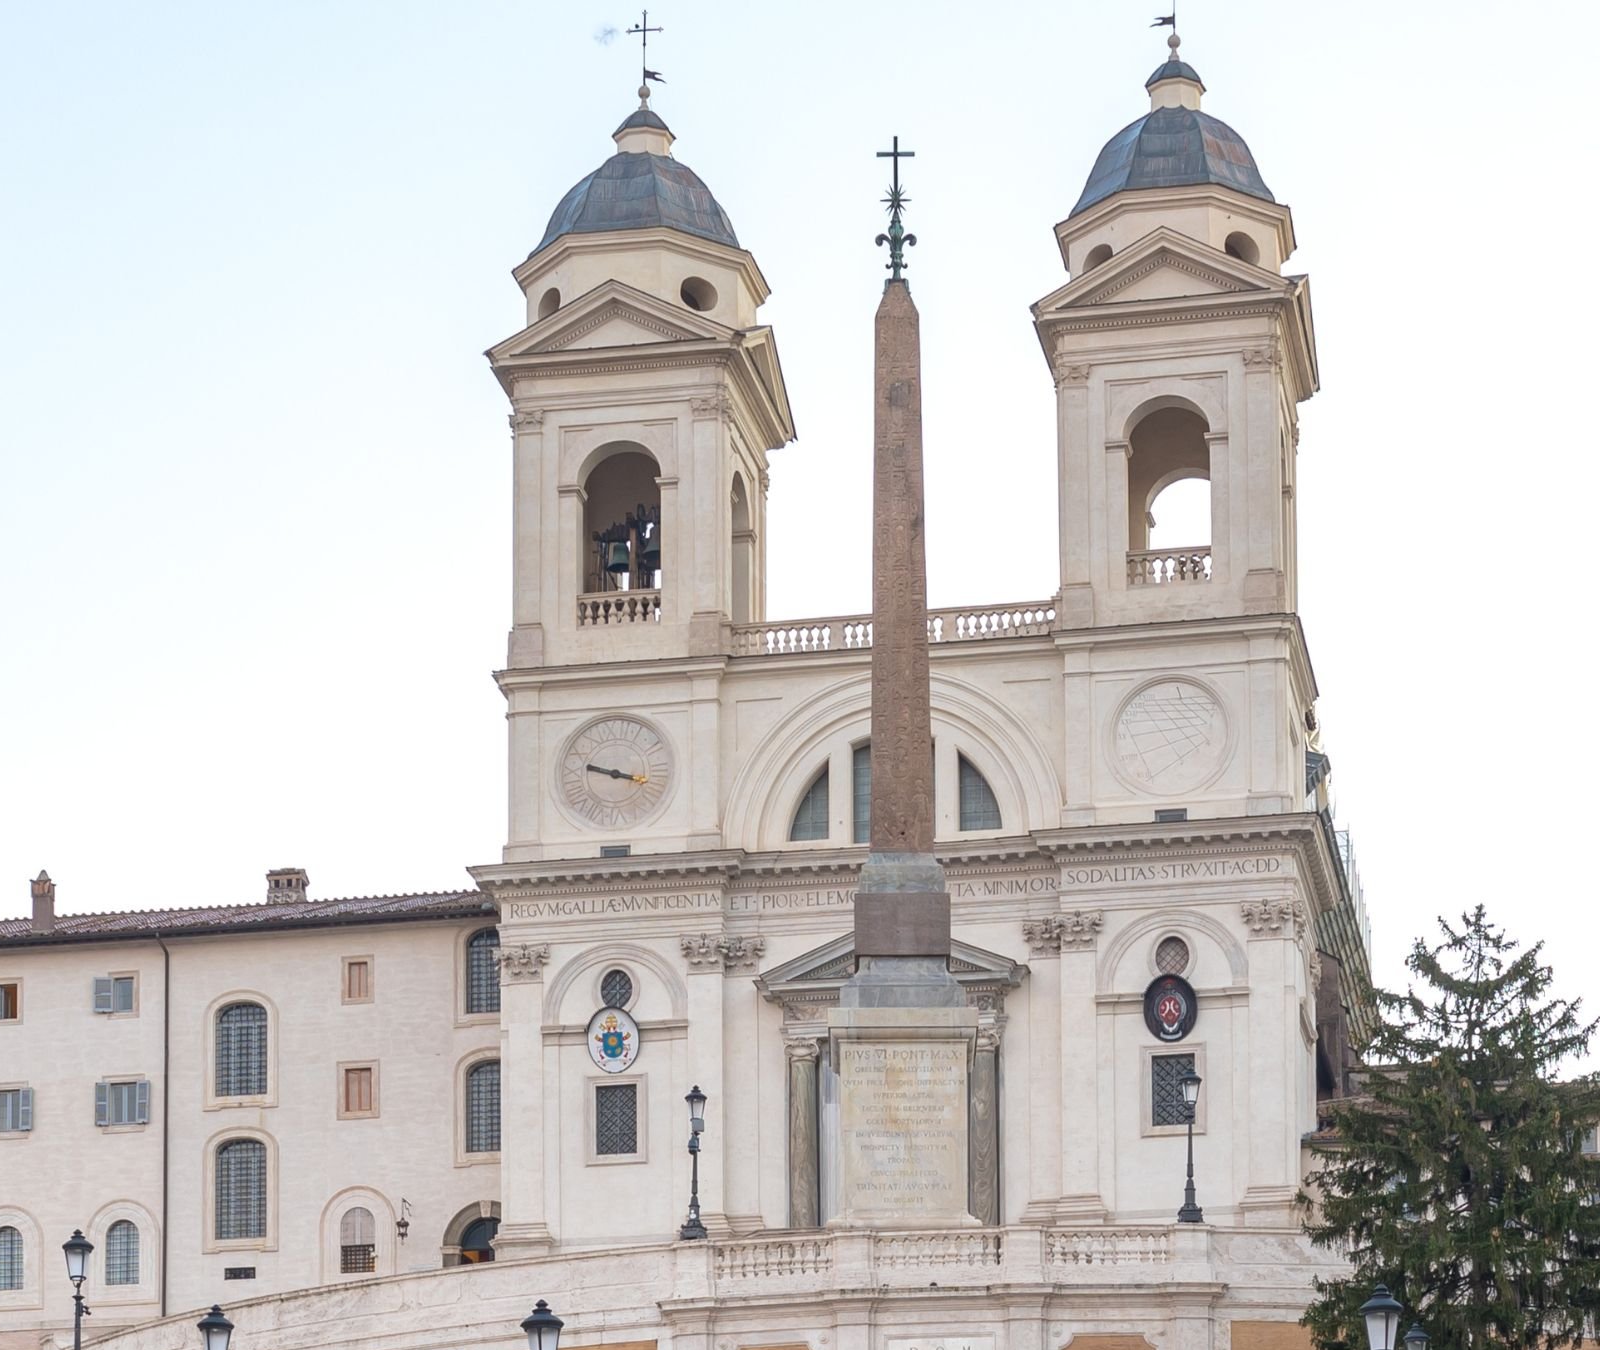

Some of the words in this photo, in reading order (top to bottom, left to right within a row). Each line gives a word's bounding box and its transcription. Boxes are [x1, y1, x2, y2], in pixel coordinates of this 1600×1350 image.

[730, 895, 752, 911] ET
[1067, 866, 1156, 884] SODALITAS
[1160, 860, 1229, 879] STRVXIT
[1231, 860, 1254, 875] AC
[844, 1050, 870, 1060] PIVS
[893, 1050, 927, 1060] PONT
[930, 1050, 959, 1060] MAX
